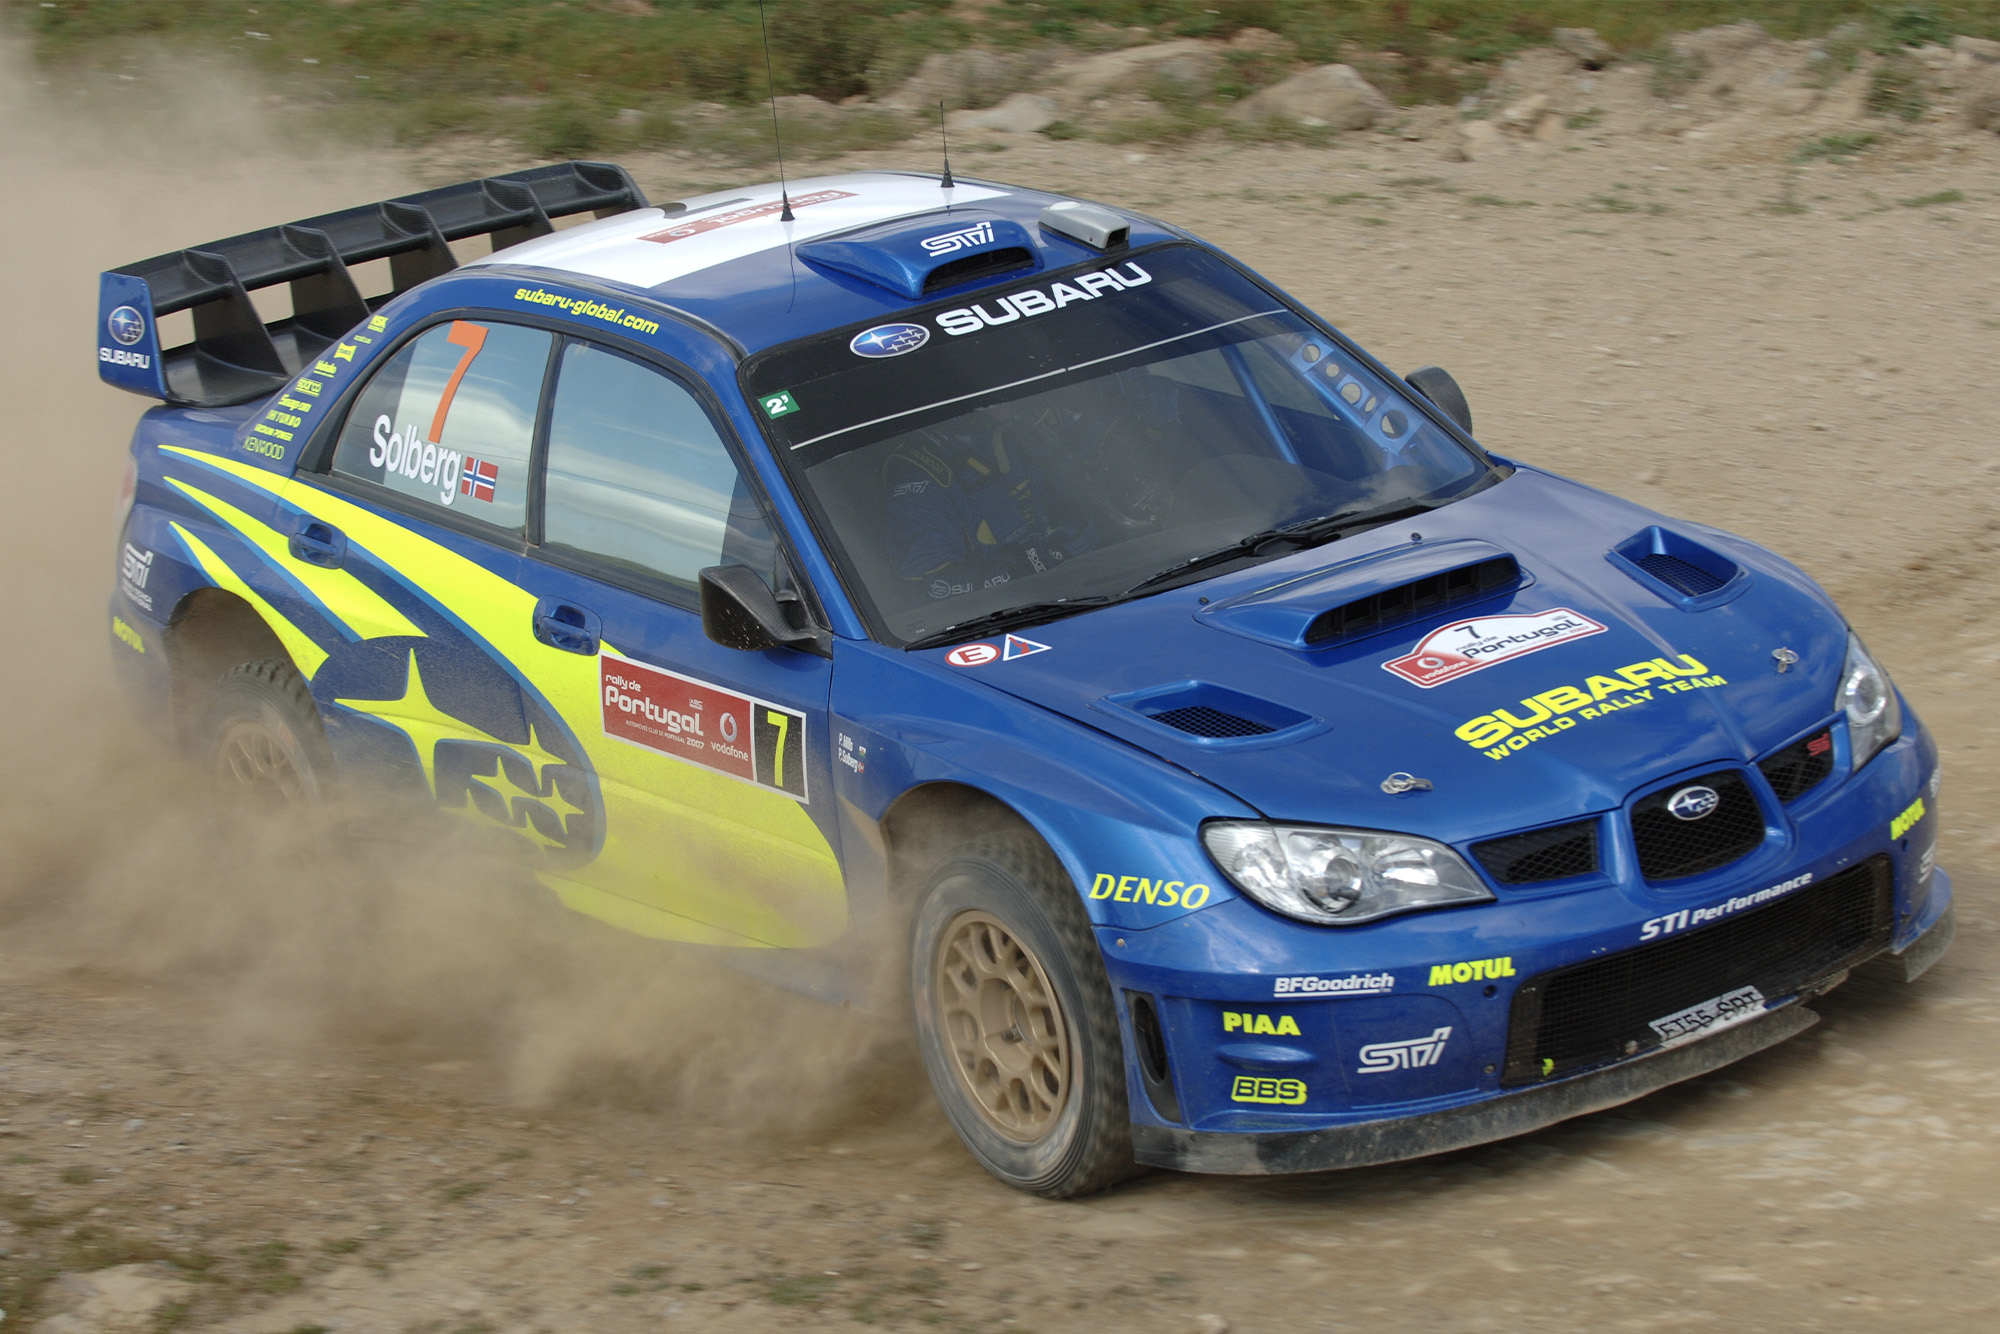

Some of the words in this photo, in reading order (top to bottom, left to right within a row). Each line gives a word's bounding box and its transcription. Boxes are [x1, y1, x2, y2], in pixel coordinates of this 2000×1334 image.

[920, 221, 995, 257] STI
[514, 288, 660, 335] subaru-global.com
[936, 261, 1152, 336] SUBARU
[99, 347, 150, 369] SUBARU
[427, 320, 490, 444] 7
[243, 437, 286, 460] KENWOOD
[369, 414, 463, 505] Solberg
[1454, 625, 1481, 639] 7
[1461, 620, 1584, 659] Portugal
[957, 646, 986, 663] E
[1421, 661, 1469, 680] vodafone
[606, 674, 628, 690] rally
[629, 680, 641, 692] de
[1453, 653, 1710, 749] SUBARU
[605, 685, 704, 736] Portugal
[1483, 716, 1577, 761] WORLD
[1579, 689, 1655, 720] RALLY
[1657, 674, 1728, 696] TEAM
[664, 733, 686, 744] PORTUGAL
[686, 736, 705, 749] 2007
[710, 741, 749, 762] vodafone
[767, 711, 788, 788] 7
[1089, 872, 1210, 909] DENSO
[1640, 908, 1690, 941] STI
[1690, 872, 1813, 926] Performance
[1274, 972, 1395, 992] BFGoodrich
[1428, 956, 1516, 987] MOTUL
[1222, 1011, 1301, 1036] PIAA
[1357, 1026, 1453, 1074] STI
[1232, 1076, 1308, 1105] BBS
